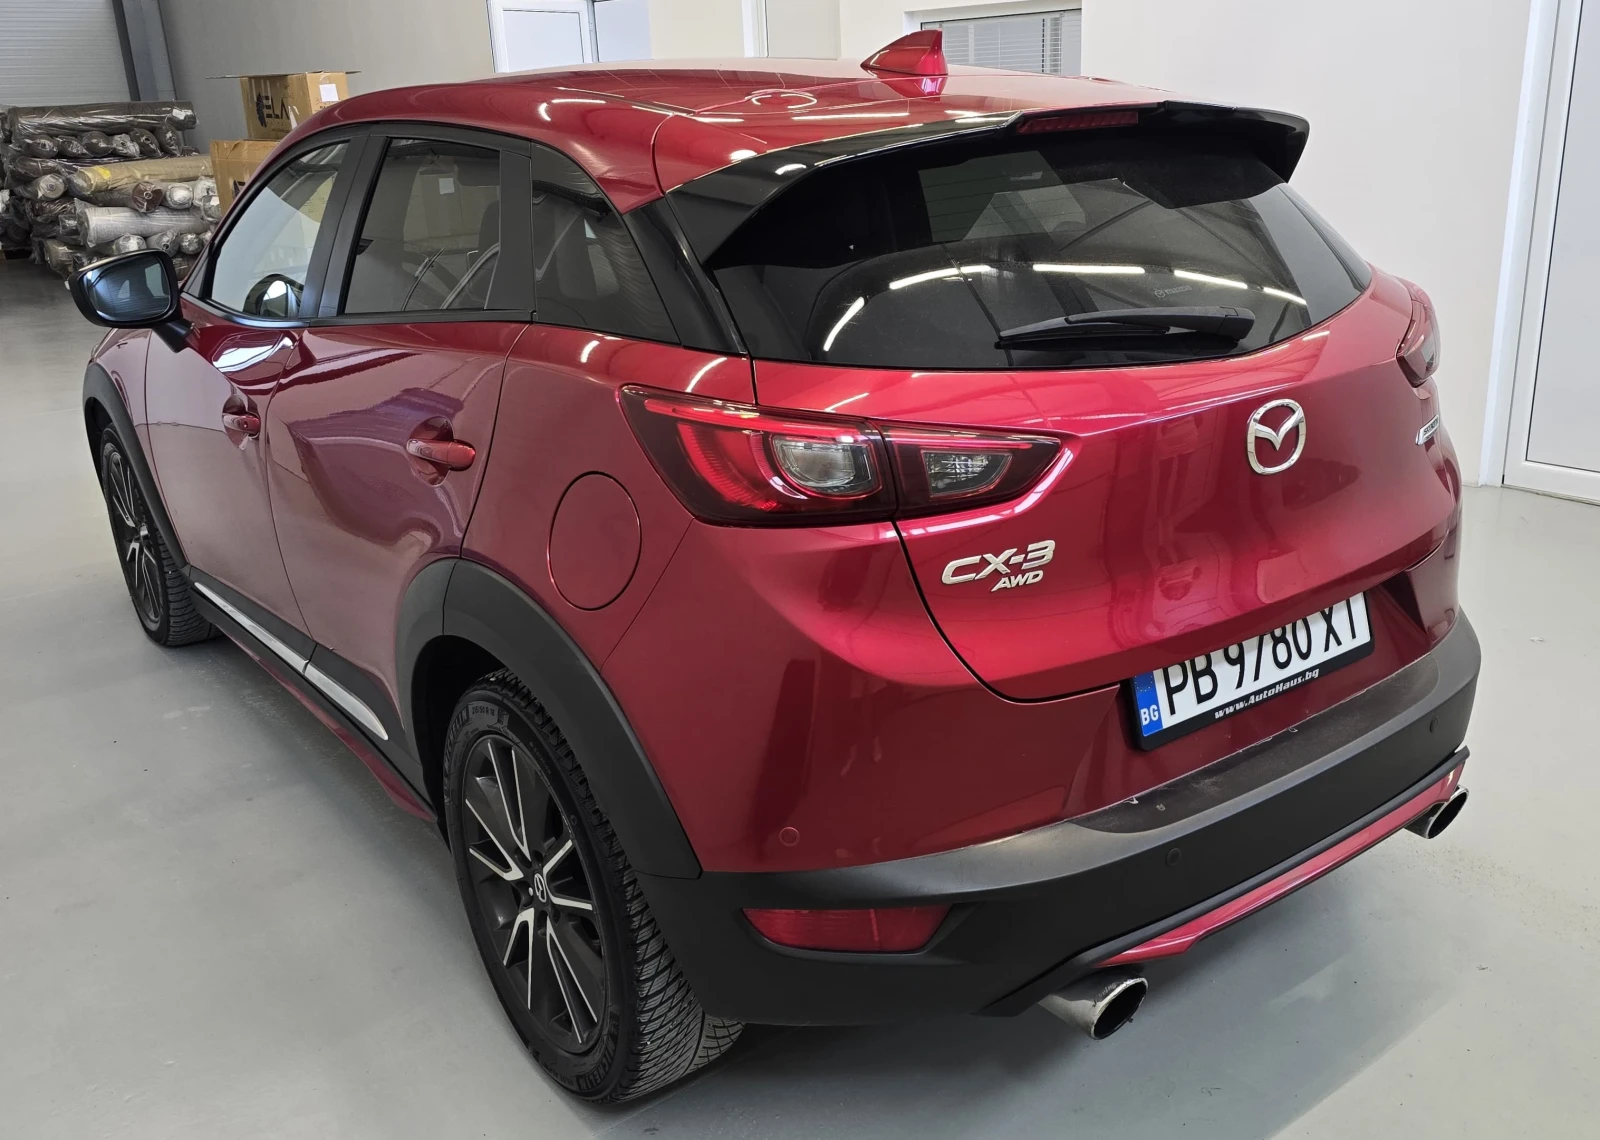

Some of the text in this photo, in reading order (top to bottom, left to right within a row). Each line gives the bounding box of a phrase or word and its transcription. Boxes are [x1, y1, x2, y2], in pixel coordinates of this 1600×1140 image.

[941, 539, 1056, 585] CX-3
[990, 569, 1044, 593] AWD
[1162, 652, 1219, 716] PB
[1214, 668, 1320, 719] www.AutoHaus.bg
[1140, 704, 1159, 726] BG
[578, 1035, 616, 1091] MICHELIN
